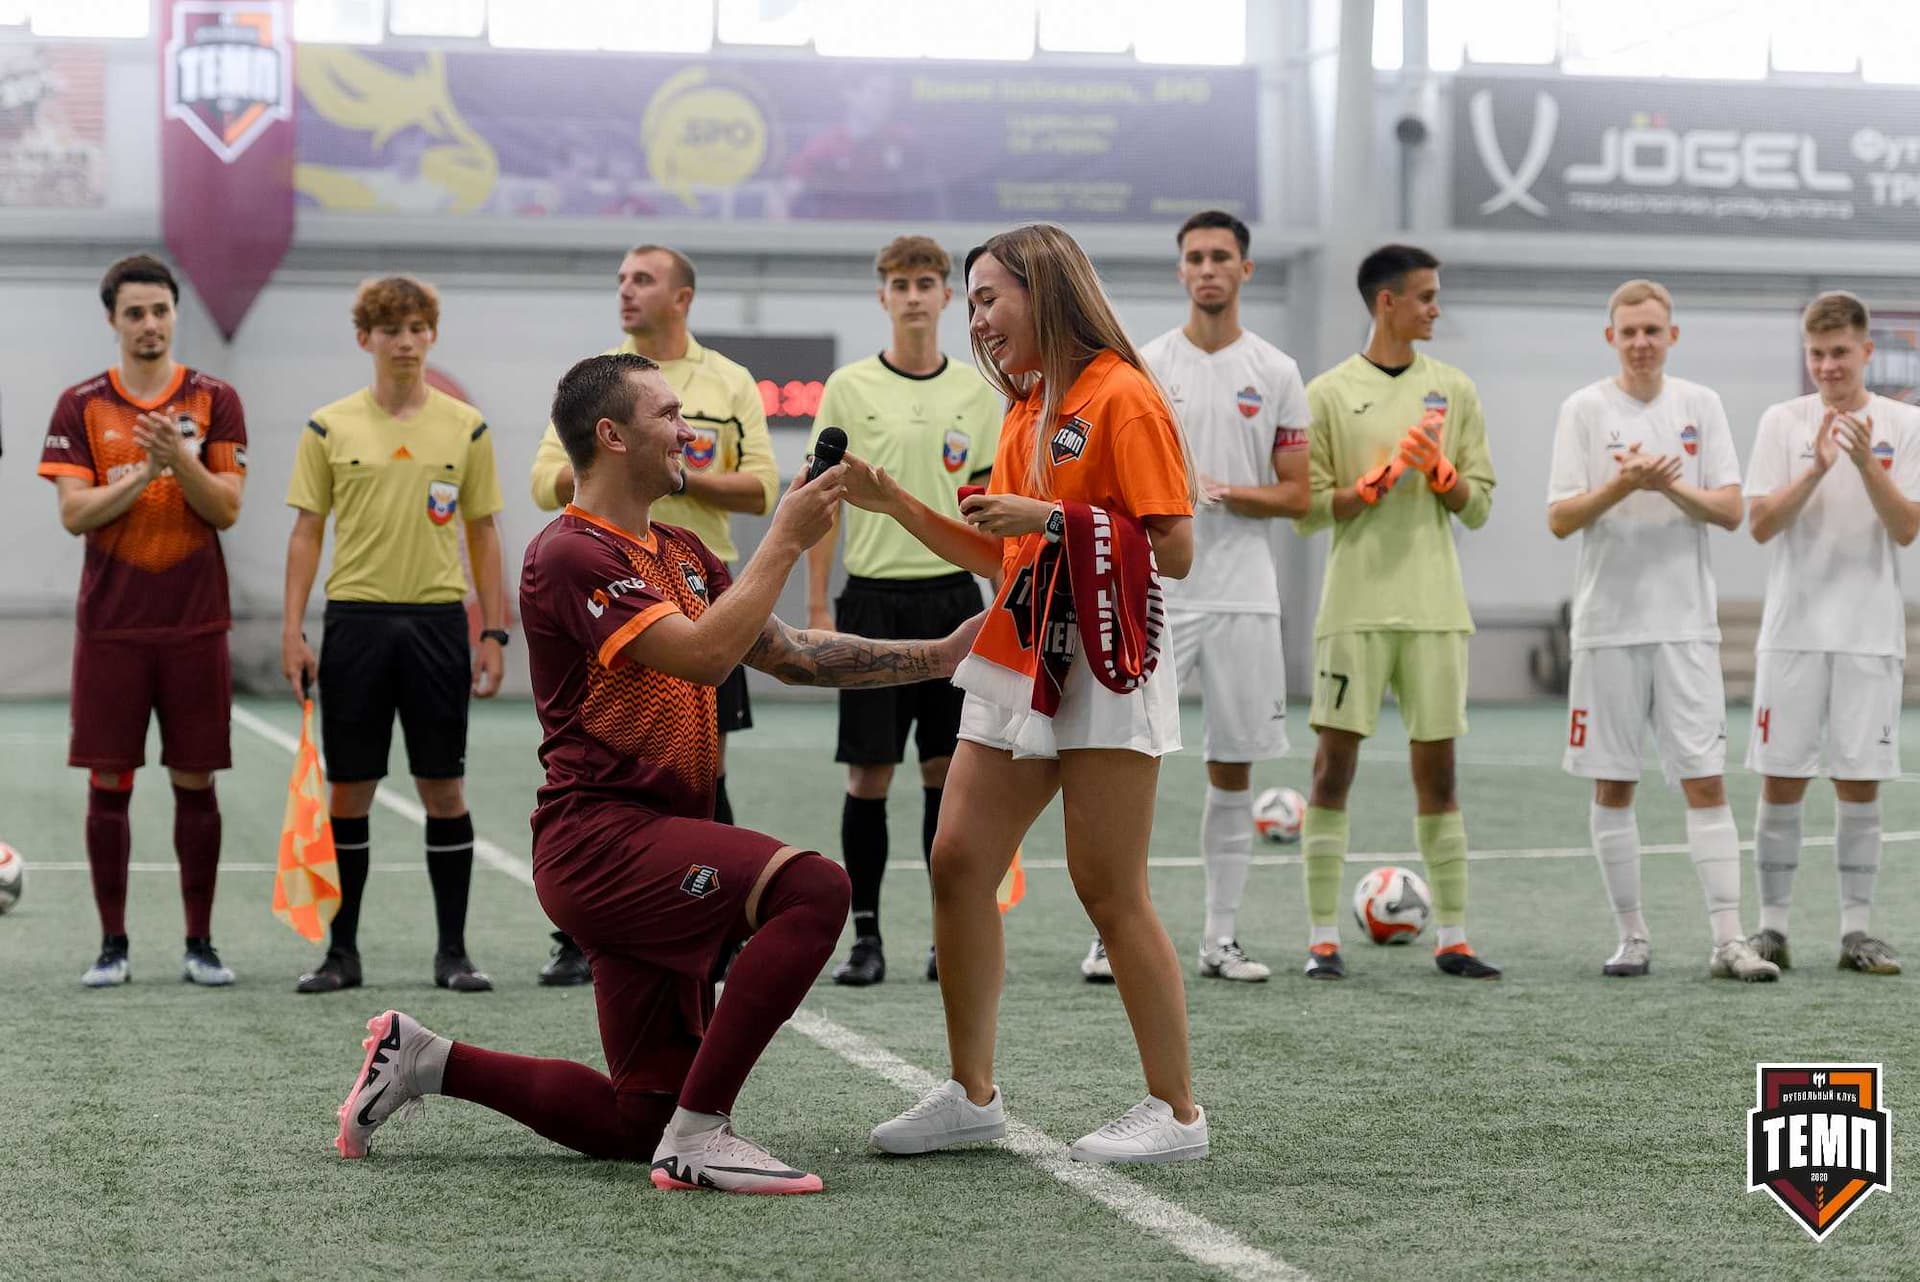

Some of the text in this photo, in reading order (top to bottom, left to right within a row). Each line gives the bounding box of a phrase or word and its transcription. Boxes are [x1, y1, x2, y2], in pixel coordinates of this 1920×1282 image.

[1054, 428, 1084, 454] ТЕМП
[1569, 708, 1588, 748] 6
[1757, 706, 1770, 744] 4
[691, 869, 713, 894] ТЕМП
